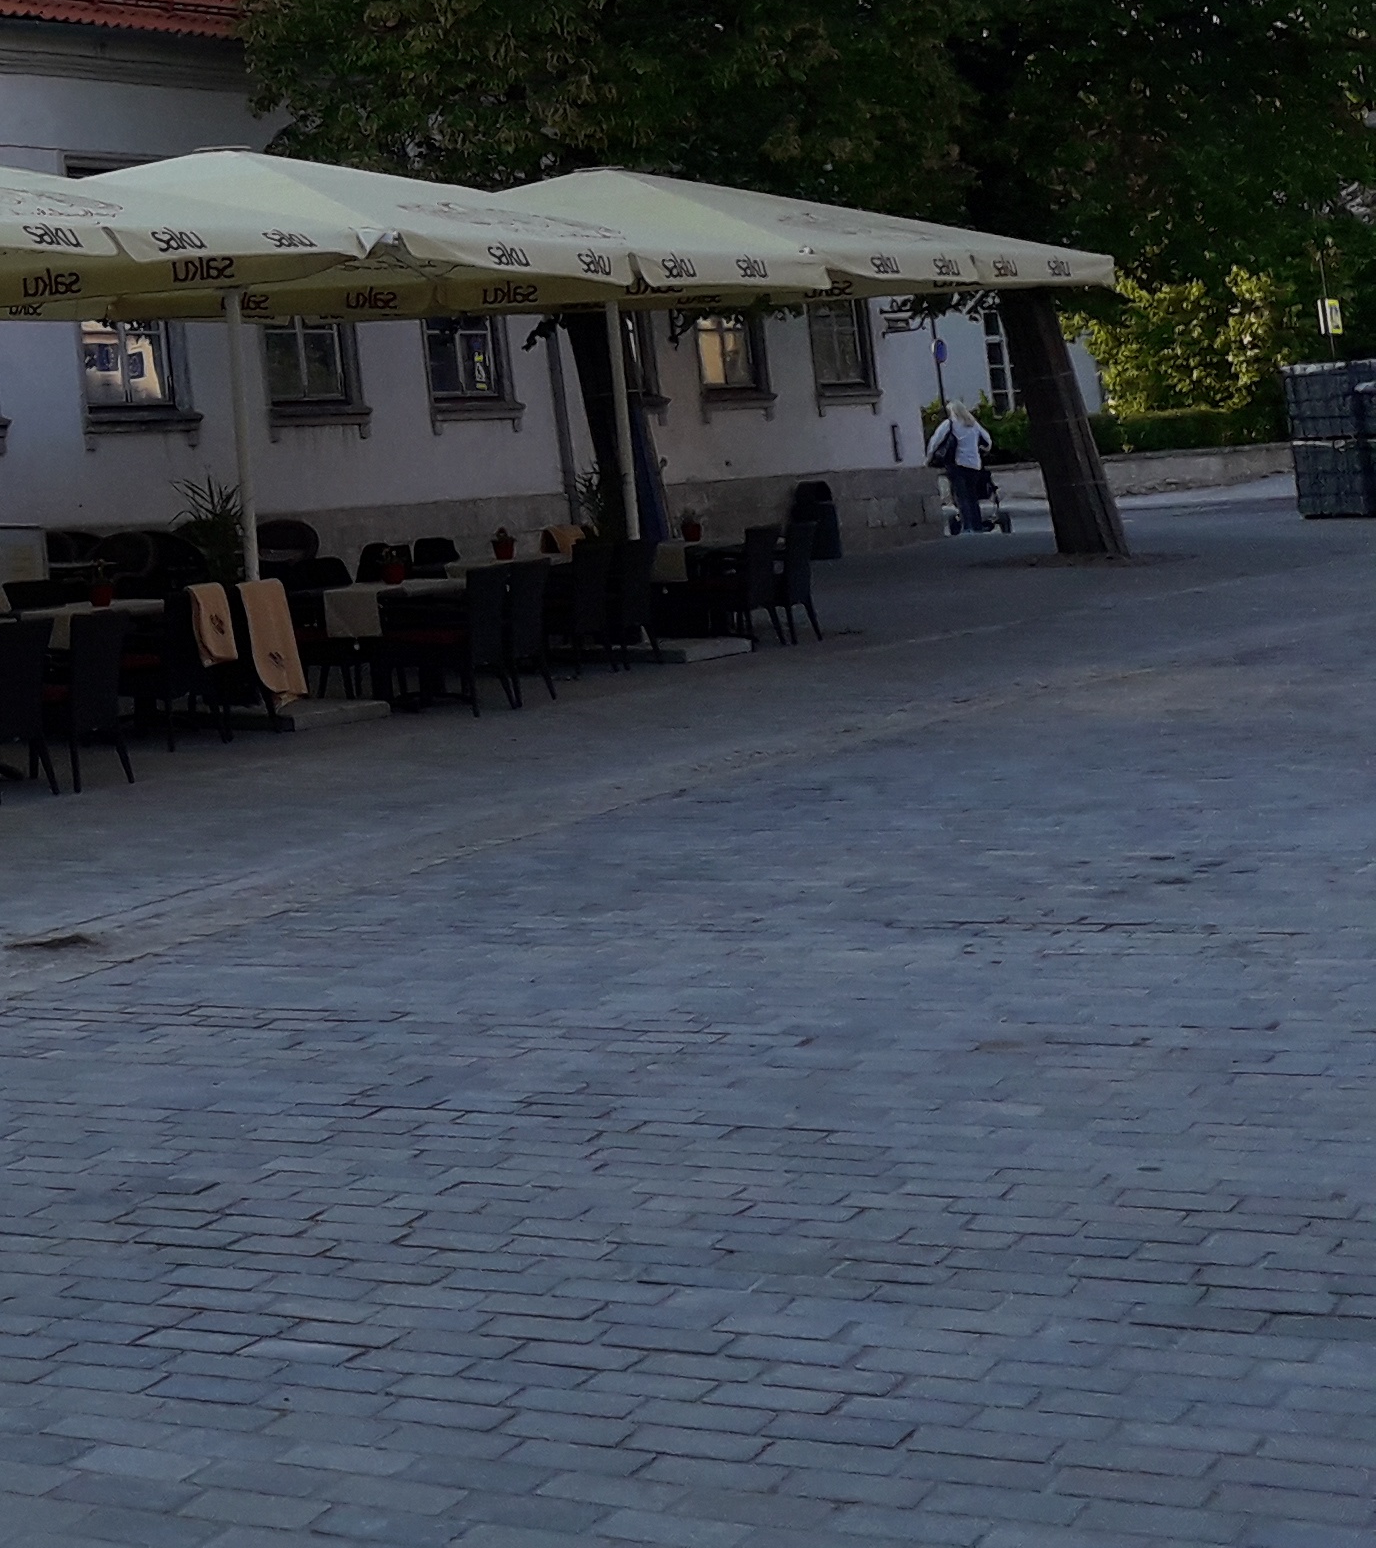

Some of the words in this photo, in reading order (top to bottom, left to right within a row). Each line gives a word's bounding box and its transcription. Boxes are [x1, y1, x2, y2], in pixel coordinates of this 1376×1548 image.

[23, 223, 84, 248] saku
[151, 227, 208, 252] saku
[262, 228, 318, 248] saku
[487, 242, 531, 267] saku
[578, 249, 612, 275] saku
[662, 251, 698, 278] saku
[736, 254, 769, 278] saku
[870, 254, 900, 274] saku
[933, 254, 961, 276] saku
[993, 254, 1018, 277] saku
[1047, 255, 1071, 277] saku
